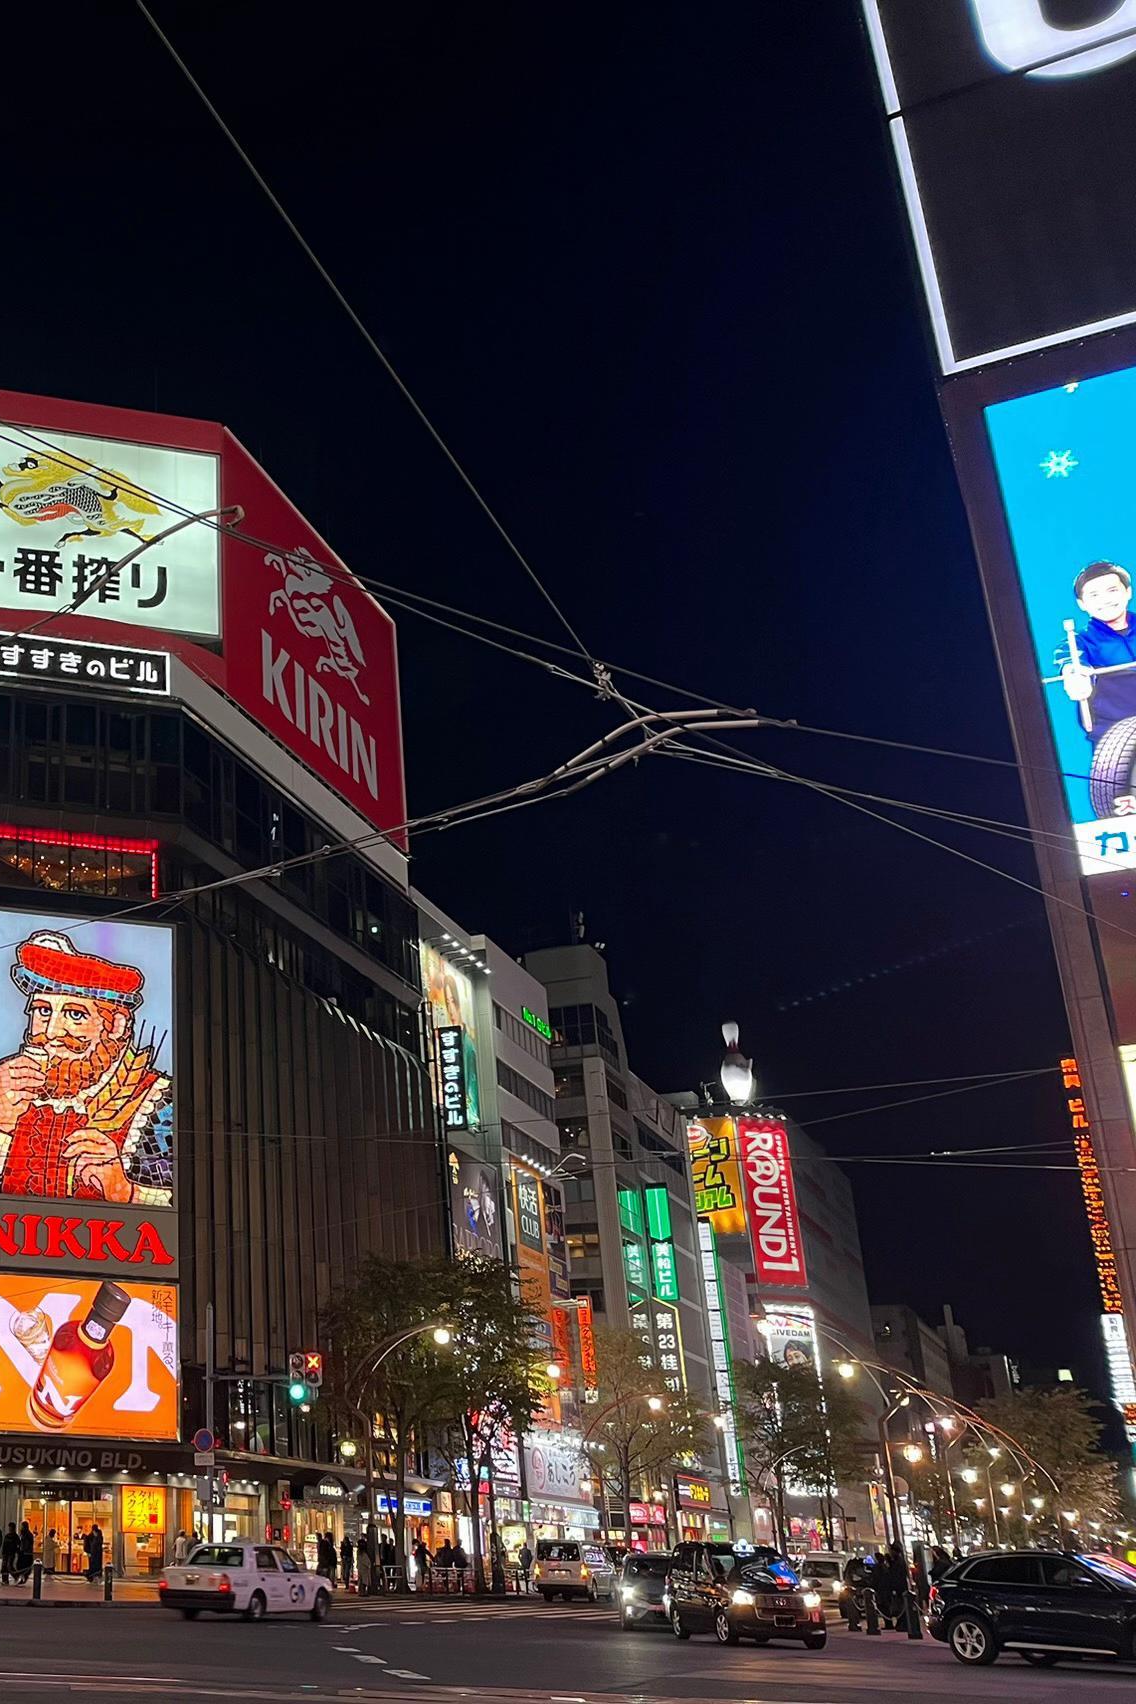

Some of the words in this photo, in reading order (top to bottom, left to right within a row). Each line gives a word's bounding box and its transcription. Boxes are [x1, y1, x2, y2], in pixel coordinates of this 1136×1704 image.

[0, 645, 159, 684] すすきのビル
[261, 628, 378, 800] KIRIN
[440, 1030, 464, 1126] すすきのビル
[521, 1214, 540, 1240] CLUB
[745, 1130, 801, 1273] ROUND1
[780, 1173, 798, 1255] ENTERTAINMENT
[100, 1453, 147, 1470] BLD.
